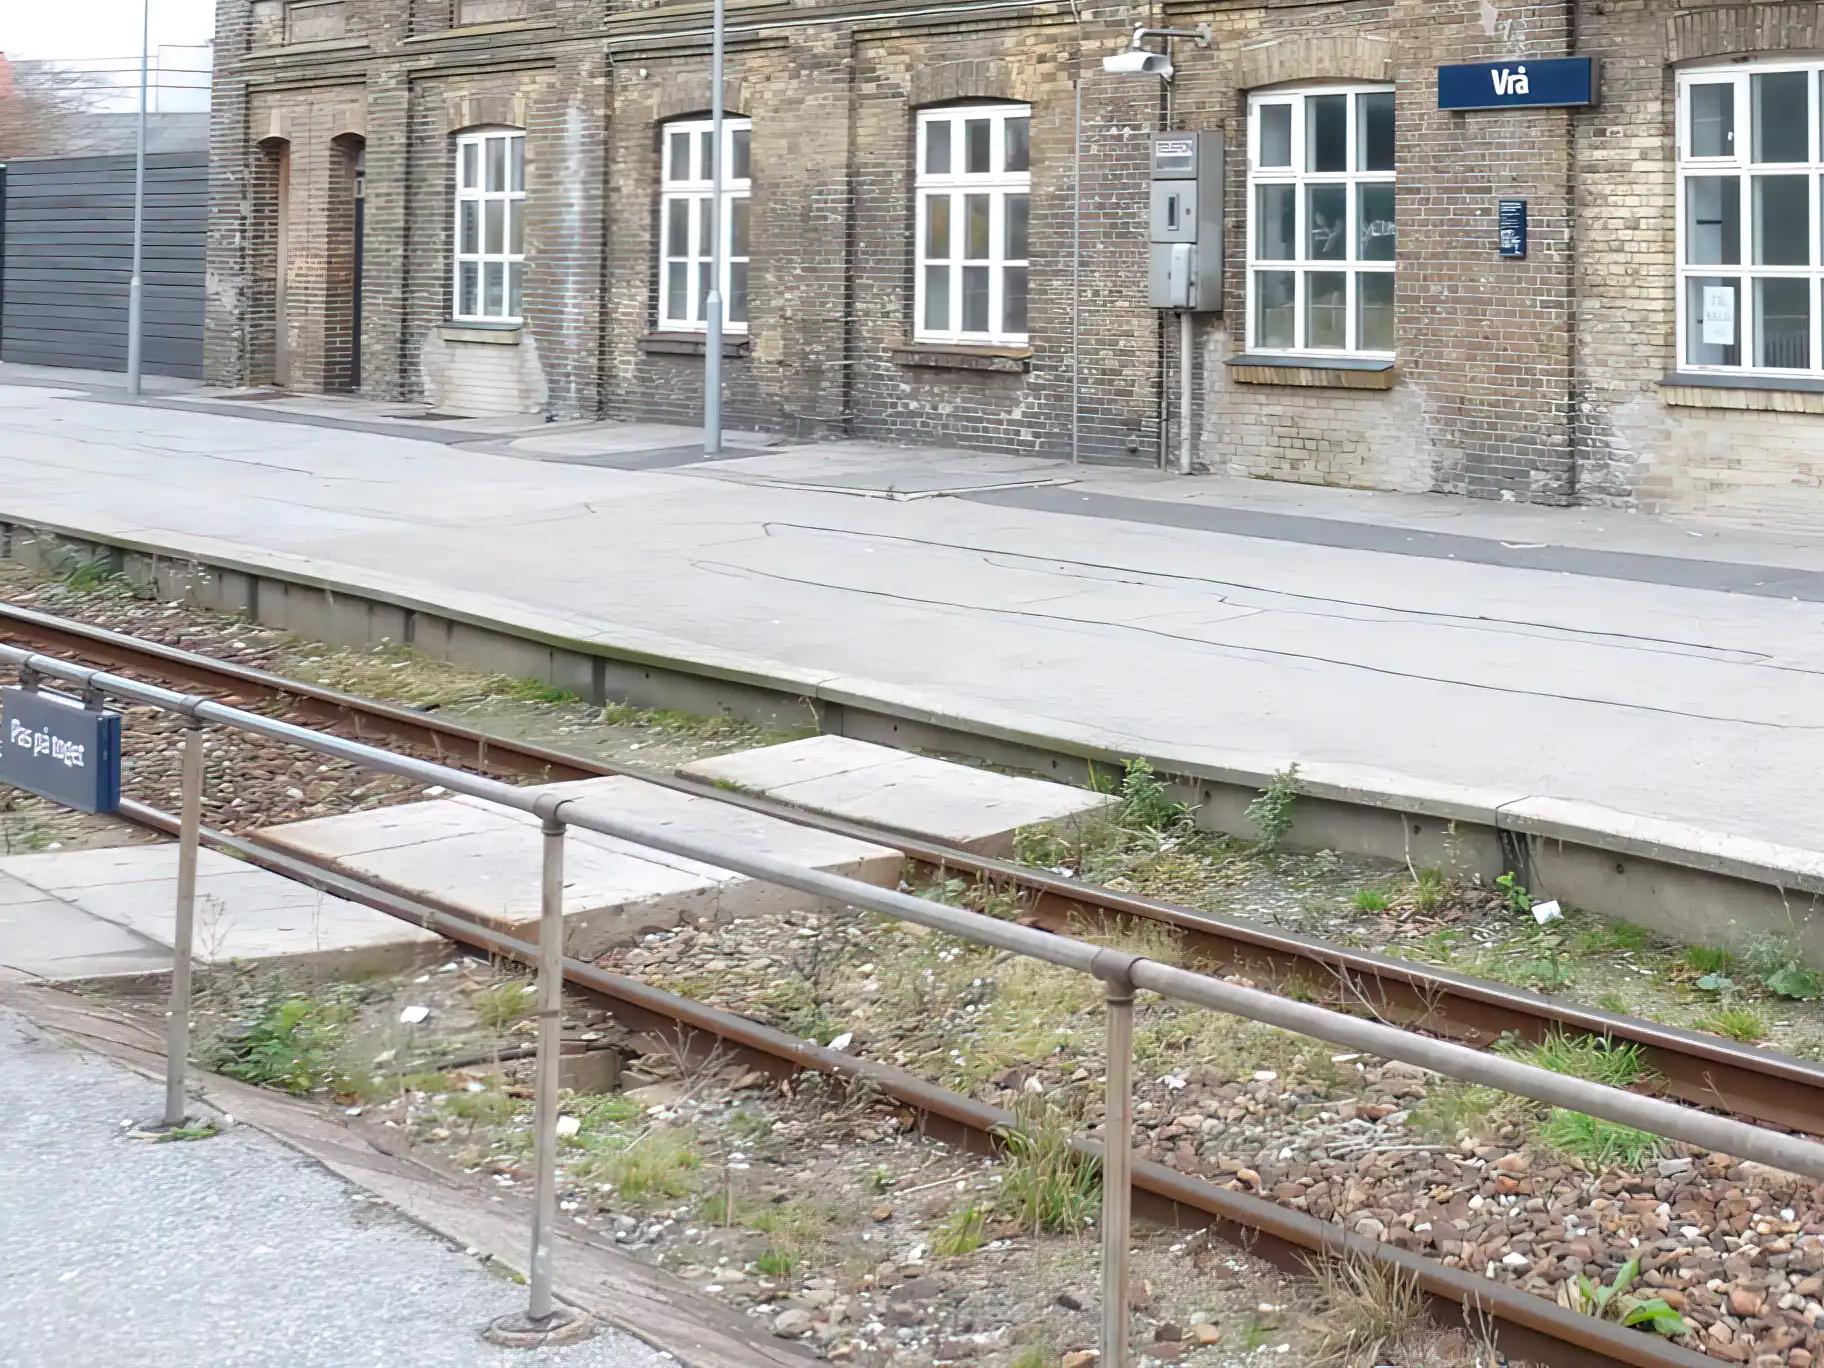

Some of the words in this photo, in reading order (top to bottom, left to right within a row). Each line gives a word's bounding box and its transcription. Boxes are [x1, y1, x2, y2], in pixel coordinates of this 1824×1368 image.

[1490, 66, 1530, 96] Vrå
[10, 718, 33, 749] Pas
[33, 726, 51, 758] på
